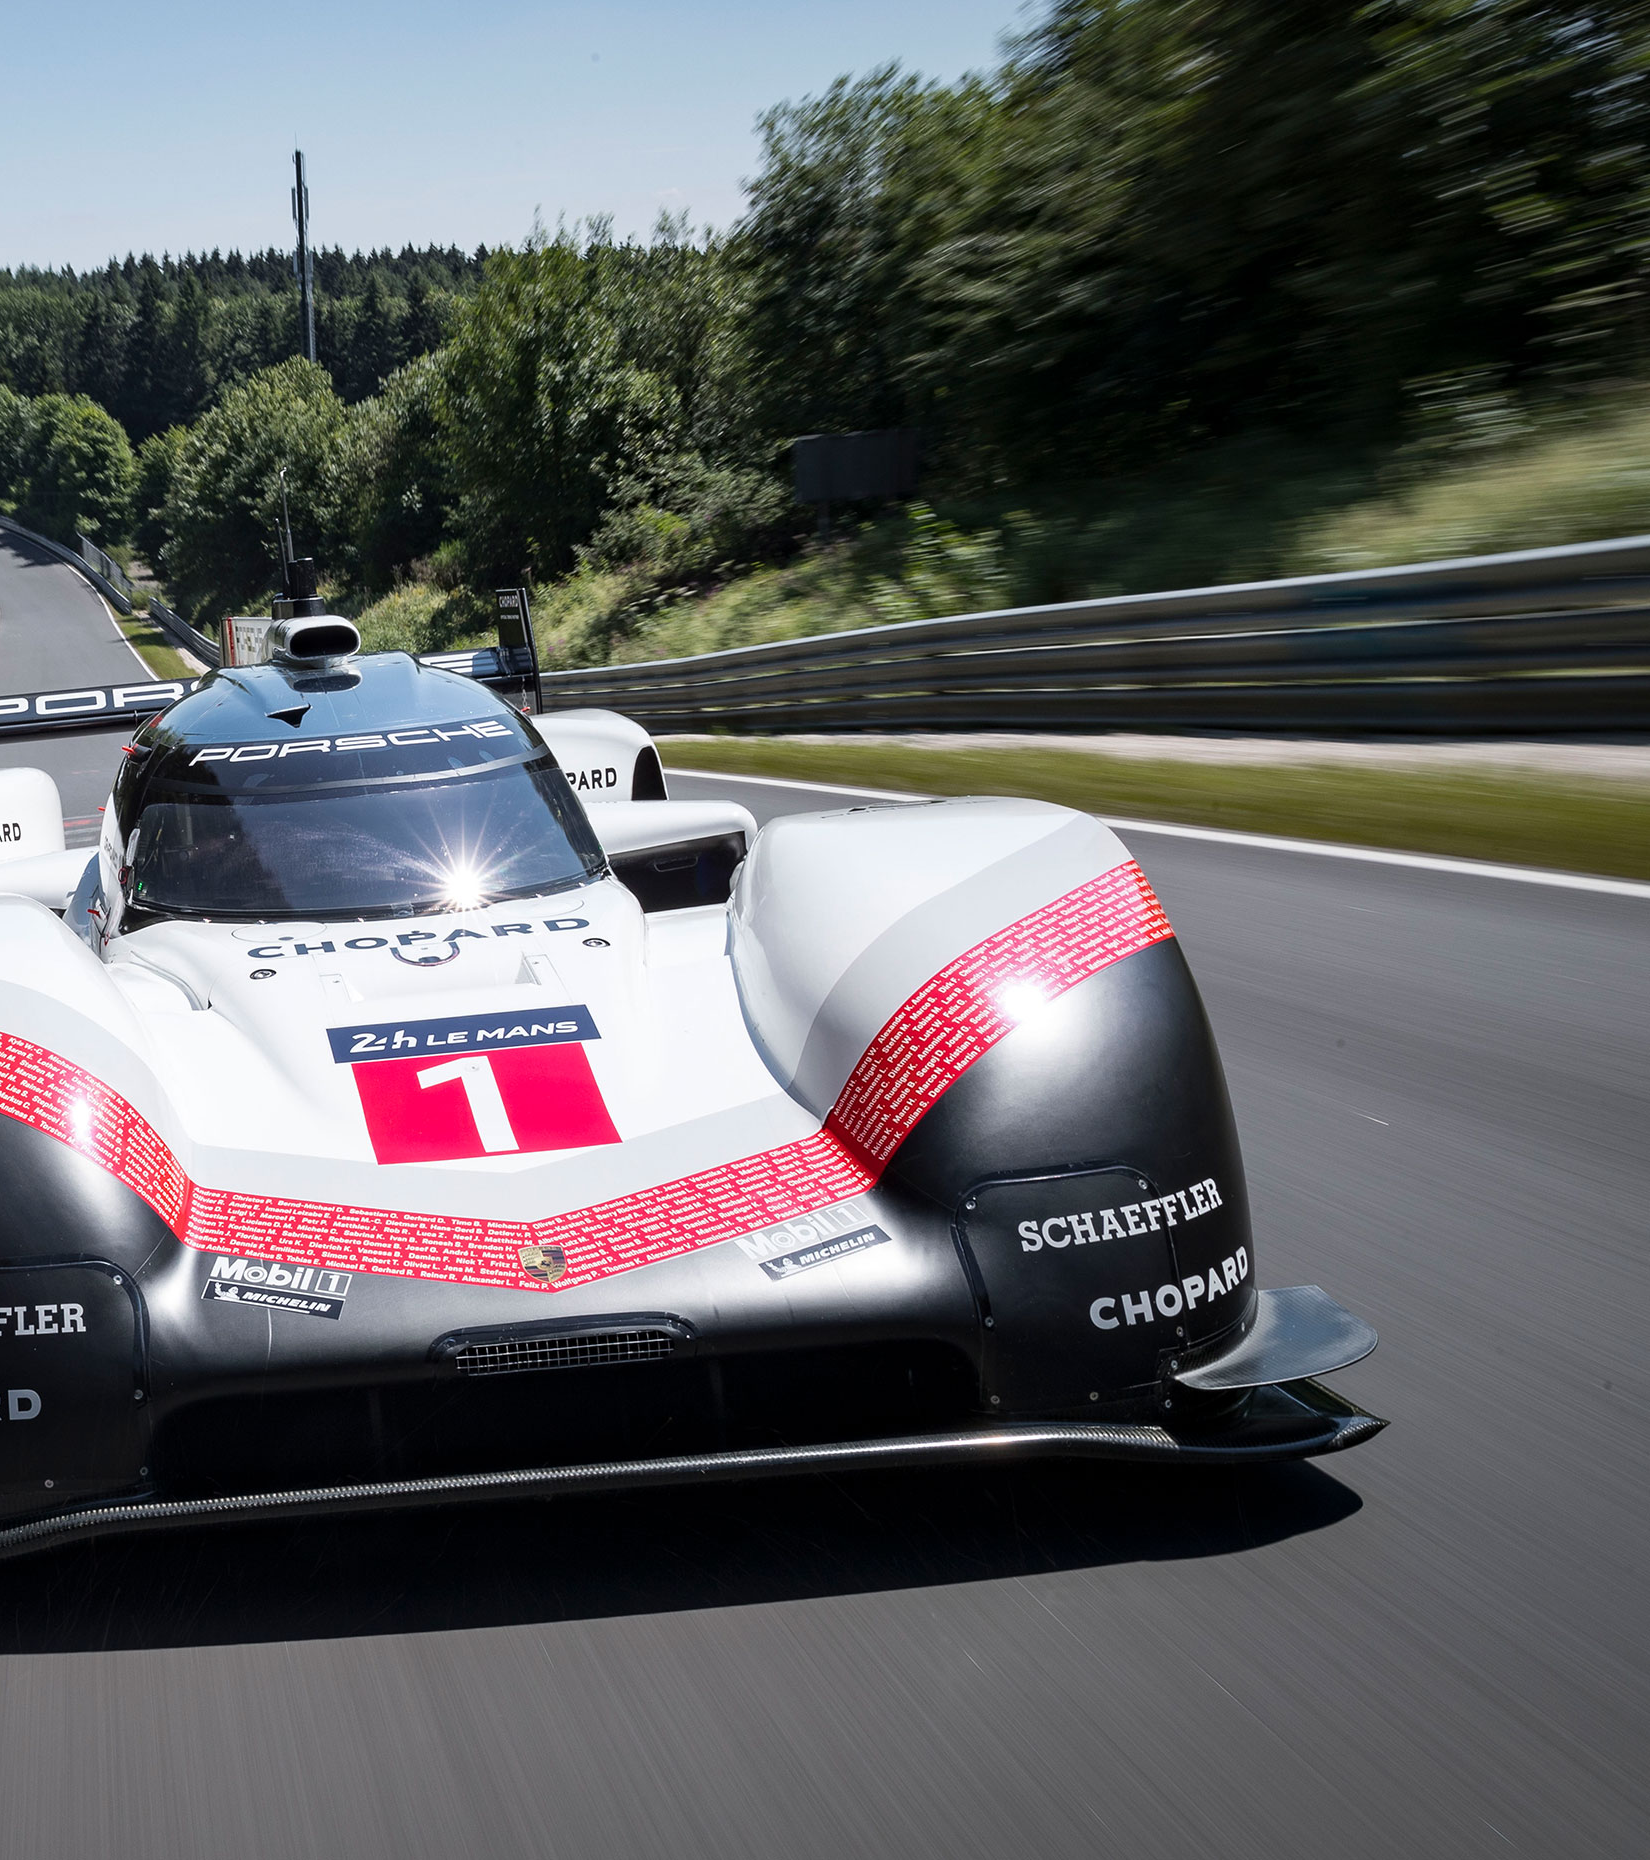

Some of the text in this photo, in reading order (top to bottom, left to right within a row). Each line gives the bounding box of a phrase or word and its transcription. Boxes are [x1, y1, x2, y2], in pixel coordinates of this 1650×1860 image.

[189, 721, 514, 767] PORSCHE
[565, 767, 617, 791] PARD
[247, 917, 590, 958] CHOPARD
[349, 1021, 579, 1054] 24h LE MANS
[833, 1086, 852, 1116] Michael
[856, 1056, 872, 1076] Joerg
[877, 1011, 906, 1044] Alexander
[911, 982, 937, 1005] Andreas
[838, 1093, 858, 1123] Dominic
[861, 1063, 877, 1083] Nigel
[882, 1031, 903, 1053] Stefan
[909, 1002, 931, 1020] Marco
[844, 1114, 855, 1130] Karl
[858, 1073, 882, 1104] Clemens
[887, 1044, 905, 1063] Peter
[912, 1013, 935, 1032] Tobias
[856, 1110, 880, 1142] Christian
[884, 1070, 911, 1101] Ruediger
[917, 1032, 947, 1061] Antonino
[951, 1003, 979, 1024] Thomas
[887, 1051, 913, 1078] Dietmar
[918, 1026, 936, 1042] Lutz
[416, 1055, 520, 1153] 1
[863, 1122, 884, 1149] Romain
[890, 1087, 910, 1110] Nicole
[945, 1030, 964, 1048] Josef
[871, 1135, 887, 1156] Akina
[892, 1105, 910, 1124] Marc
[915, 1073, 938, 1095] Marco
[943, 1040, 971, 1064] Kristian
[878, 1138, 897, 1160] Volker
[903, 1107, 923, 1128] Julian
[928, 1078, 949, 1098] Deniz
[953, 1050, 978, 1071] Martin
[735, 1209, 828, 1259] Mobil
[800, 1232, 876, 1266] MICHELIN
[1017, 1178, 1223, 1252] SCHAEFFLER
[209, 1256, 313, 1291] Mobil
[242, 1291, 331, 1312] MICHELIN
[1089, 1246, 1248, 1329] CHOPARD
